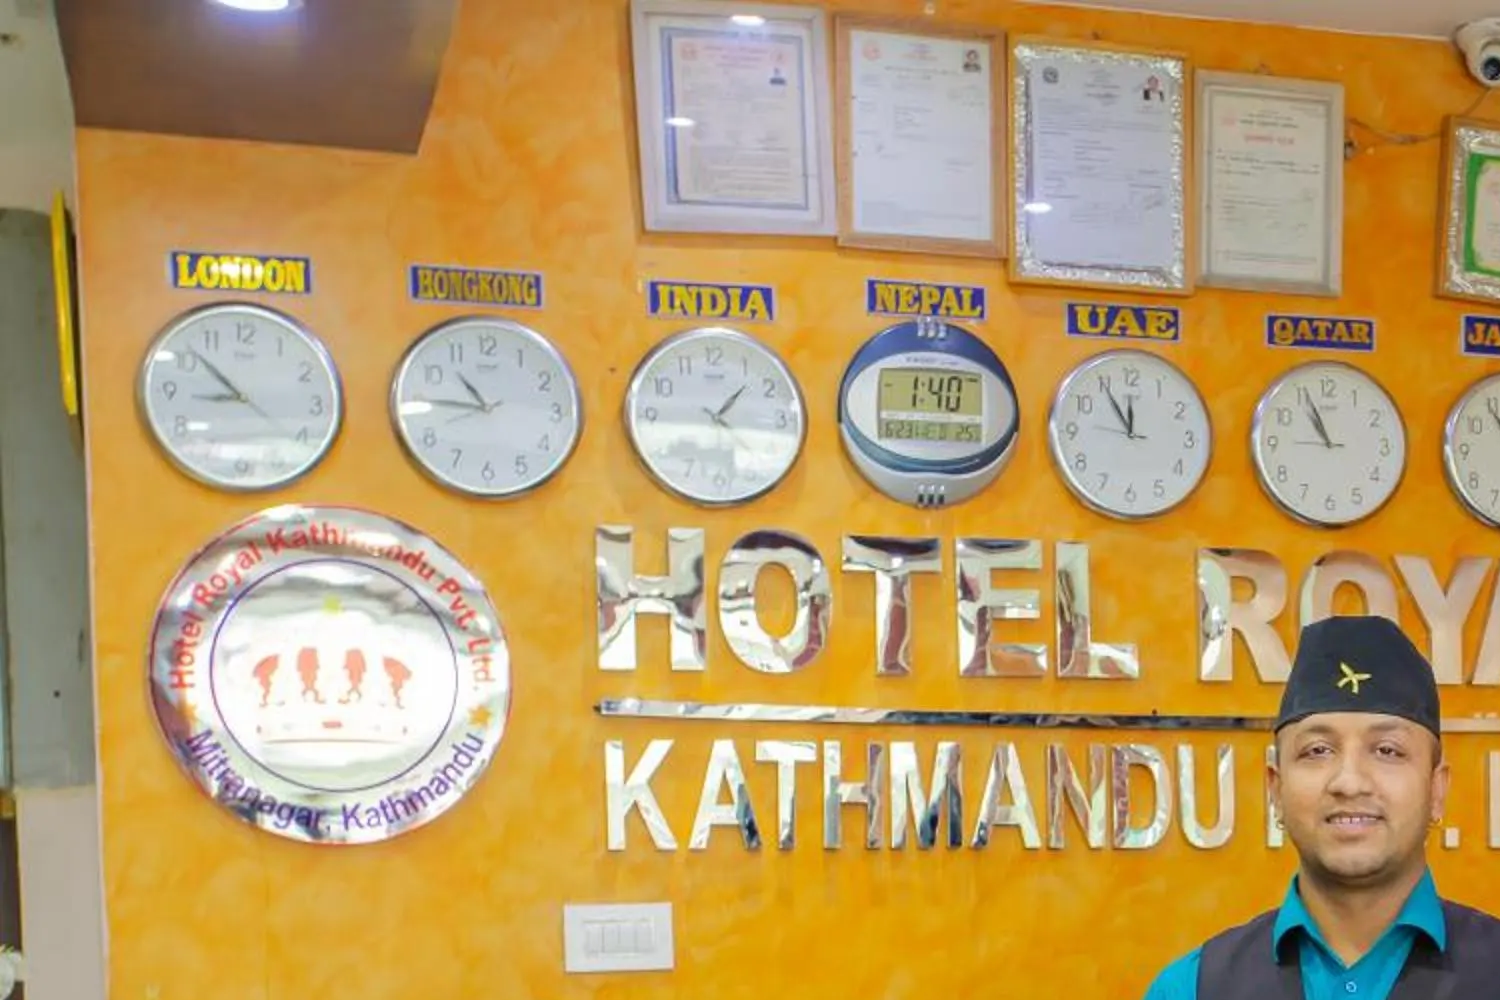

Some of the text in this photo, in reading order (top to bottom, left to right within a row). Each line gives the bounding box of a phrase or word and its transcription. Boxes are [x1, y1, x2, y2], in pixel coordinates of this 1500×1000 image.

[176, 255, 306, 292] LONDON
[417, 268, 538, 306] HONGKONG
[657, 284, 770, 320] INDIA
[874, 284, 983, 317] NEPAL
[1074, 305, 1176, 339] UAE
[1273, 318, 1370, 345] QATAR
[203, 330, 220, 351] 11
[236, 323, 256, 345] 12
[449, 342, 463, 363] 11
[478, 335, 498, 356] 12
[678, 356, 692, 376] 11
[705, 347, 723, 367] 12
[298, 361, 314, 383] 2
[424, 364, 443, 385] 10
[538, 372, 551, 392] 2
[1123, 368, 1140, 388] 12
[162, 381, 177, 401] 9
[654, 378, 673, 397] 10
[763, 378, 776, 399] 2
[912, 375, 963, 412] 1:40
[1320, 379, 1337, 399] 12
[310, 395, 323, 417] 3
[550, 403, 562, 423] 3
[1076, 395, 1093, 415] 10
[1174, 401, 1185, 420] 2
[775, 411, 787, 429] 3
[1276, 407, 1293, 426] 10
[1369, 409, 1381, 428] 2
[1467, 416, 1483, 435] 10
[422, 427, 437, 448] 8
[1066, 422, 1079, 440] 9
[1183, 430, 1195, 449] 3
[538, 434, 550, 451] 4
[1267, 435, 1279, 453] 9
[1378, 438, 1391, 457] 3
[1460, 443, 1470, 461] 9
[451, 449, 462, 469] 7
[514, 455, 528, 476] 5
[1075, 453, 1087, 472] 8
[1173, 459, 1183, 476] 4
[481, 461, 496, 481] 6
[1098, 473, 1108, 489] 7
[1277, 465, 1289, 482] 8
[1369, 466, 1380, 483] 4
[1468, 472, 1480, 490] 8
[1124, 484, 1137, 502] 6
[1153, 480, 1165, 497] 5
[1299, 483, 1310, 500] 7
[1351, 487, 1363, 505] 5
[1490, 489, 1500, 508] 7
[1324, 494, 1336, 511] 6
[169, 611, 204, 689] Hotel
[192, 541, 263, 609] Royal
[266, 521, 436, 580] Kathndu
[437, 577, 477, 631] Pvt.
[596, 526, 1140, 679] HOTEL
[341, 732, 485, 831] Kathmandu
[604, 739, 1235, 851] KATHMANDU
